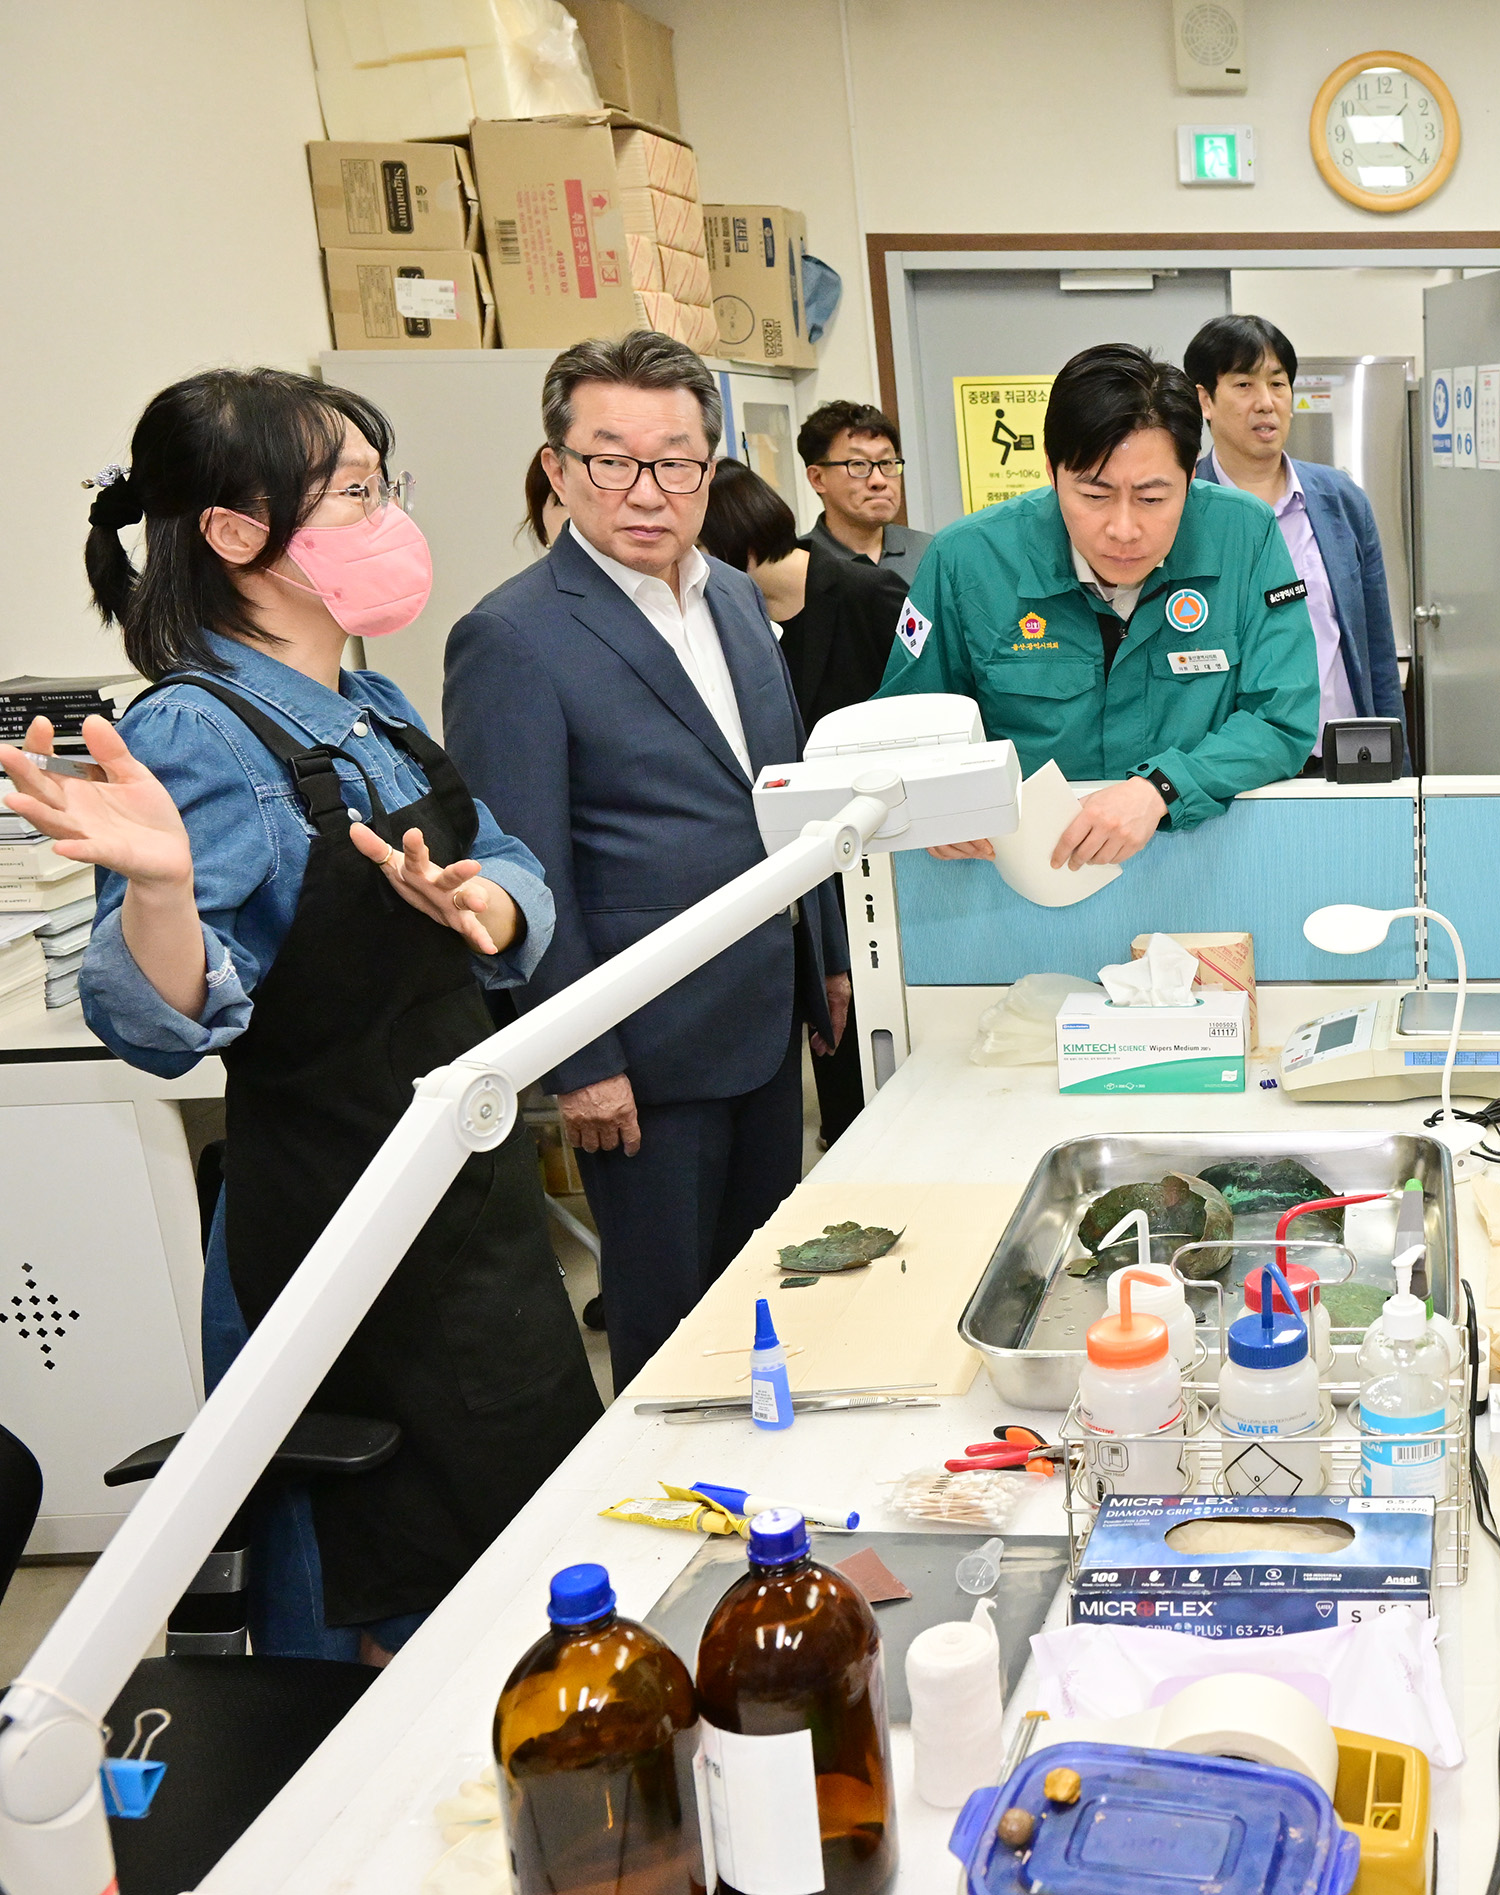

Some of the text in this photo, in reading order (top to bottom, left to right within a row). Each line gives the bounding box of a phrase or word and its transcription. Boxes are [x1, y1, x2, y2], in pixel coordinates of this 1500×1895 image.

[1357, 83, 1368, 100] 11
[1377, 76, 1392, 94] 12
[1403, 82, 1409, 98] 1
[1341, 100, 1355, 117] 10
[1418, 98, 1429, 116] 2
[1335, 125, 1345, 143] 9
[1425, 122, 1435, 140] 3
[1342, 148, 1354, 166] 8
[1418, 148, 1429, 164] 4
[393, 168, 408, 228] Signature
[571, 212, 591, 267] 취급주의
[764, 321, 775, 356] 42023
[968, 390, 1048, 405] 중량물 취급장소
[1269, 584, 1306, 603] 울산광역시 의회
[1211, 1028, 1235, 1036] 41117
[1063, 1043, 1117, 1052] KIMTECH
[1118, 1044, 1146, 1052] SCIENCE
[1149, 1044, 1172, 1053] Wipers
[1237, 1421, 1279, 1434] WATER
[1106, 1508, 1165, 1518] DIAMOND
[1166, 1508, 1193, 1516] GRIP
[1251, 1506, 1297, 1514] 63-754
[1361, 1501, 1371, 1509] S
[1091, 1572, 1119, 1583] 100
[1385, 1575, 1418, 1583] Ansell
[1351, 1609, 1362, 1624] S
[1235, 1625, 1284, 1636] 63-754
